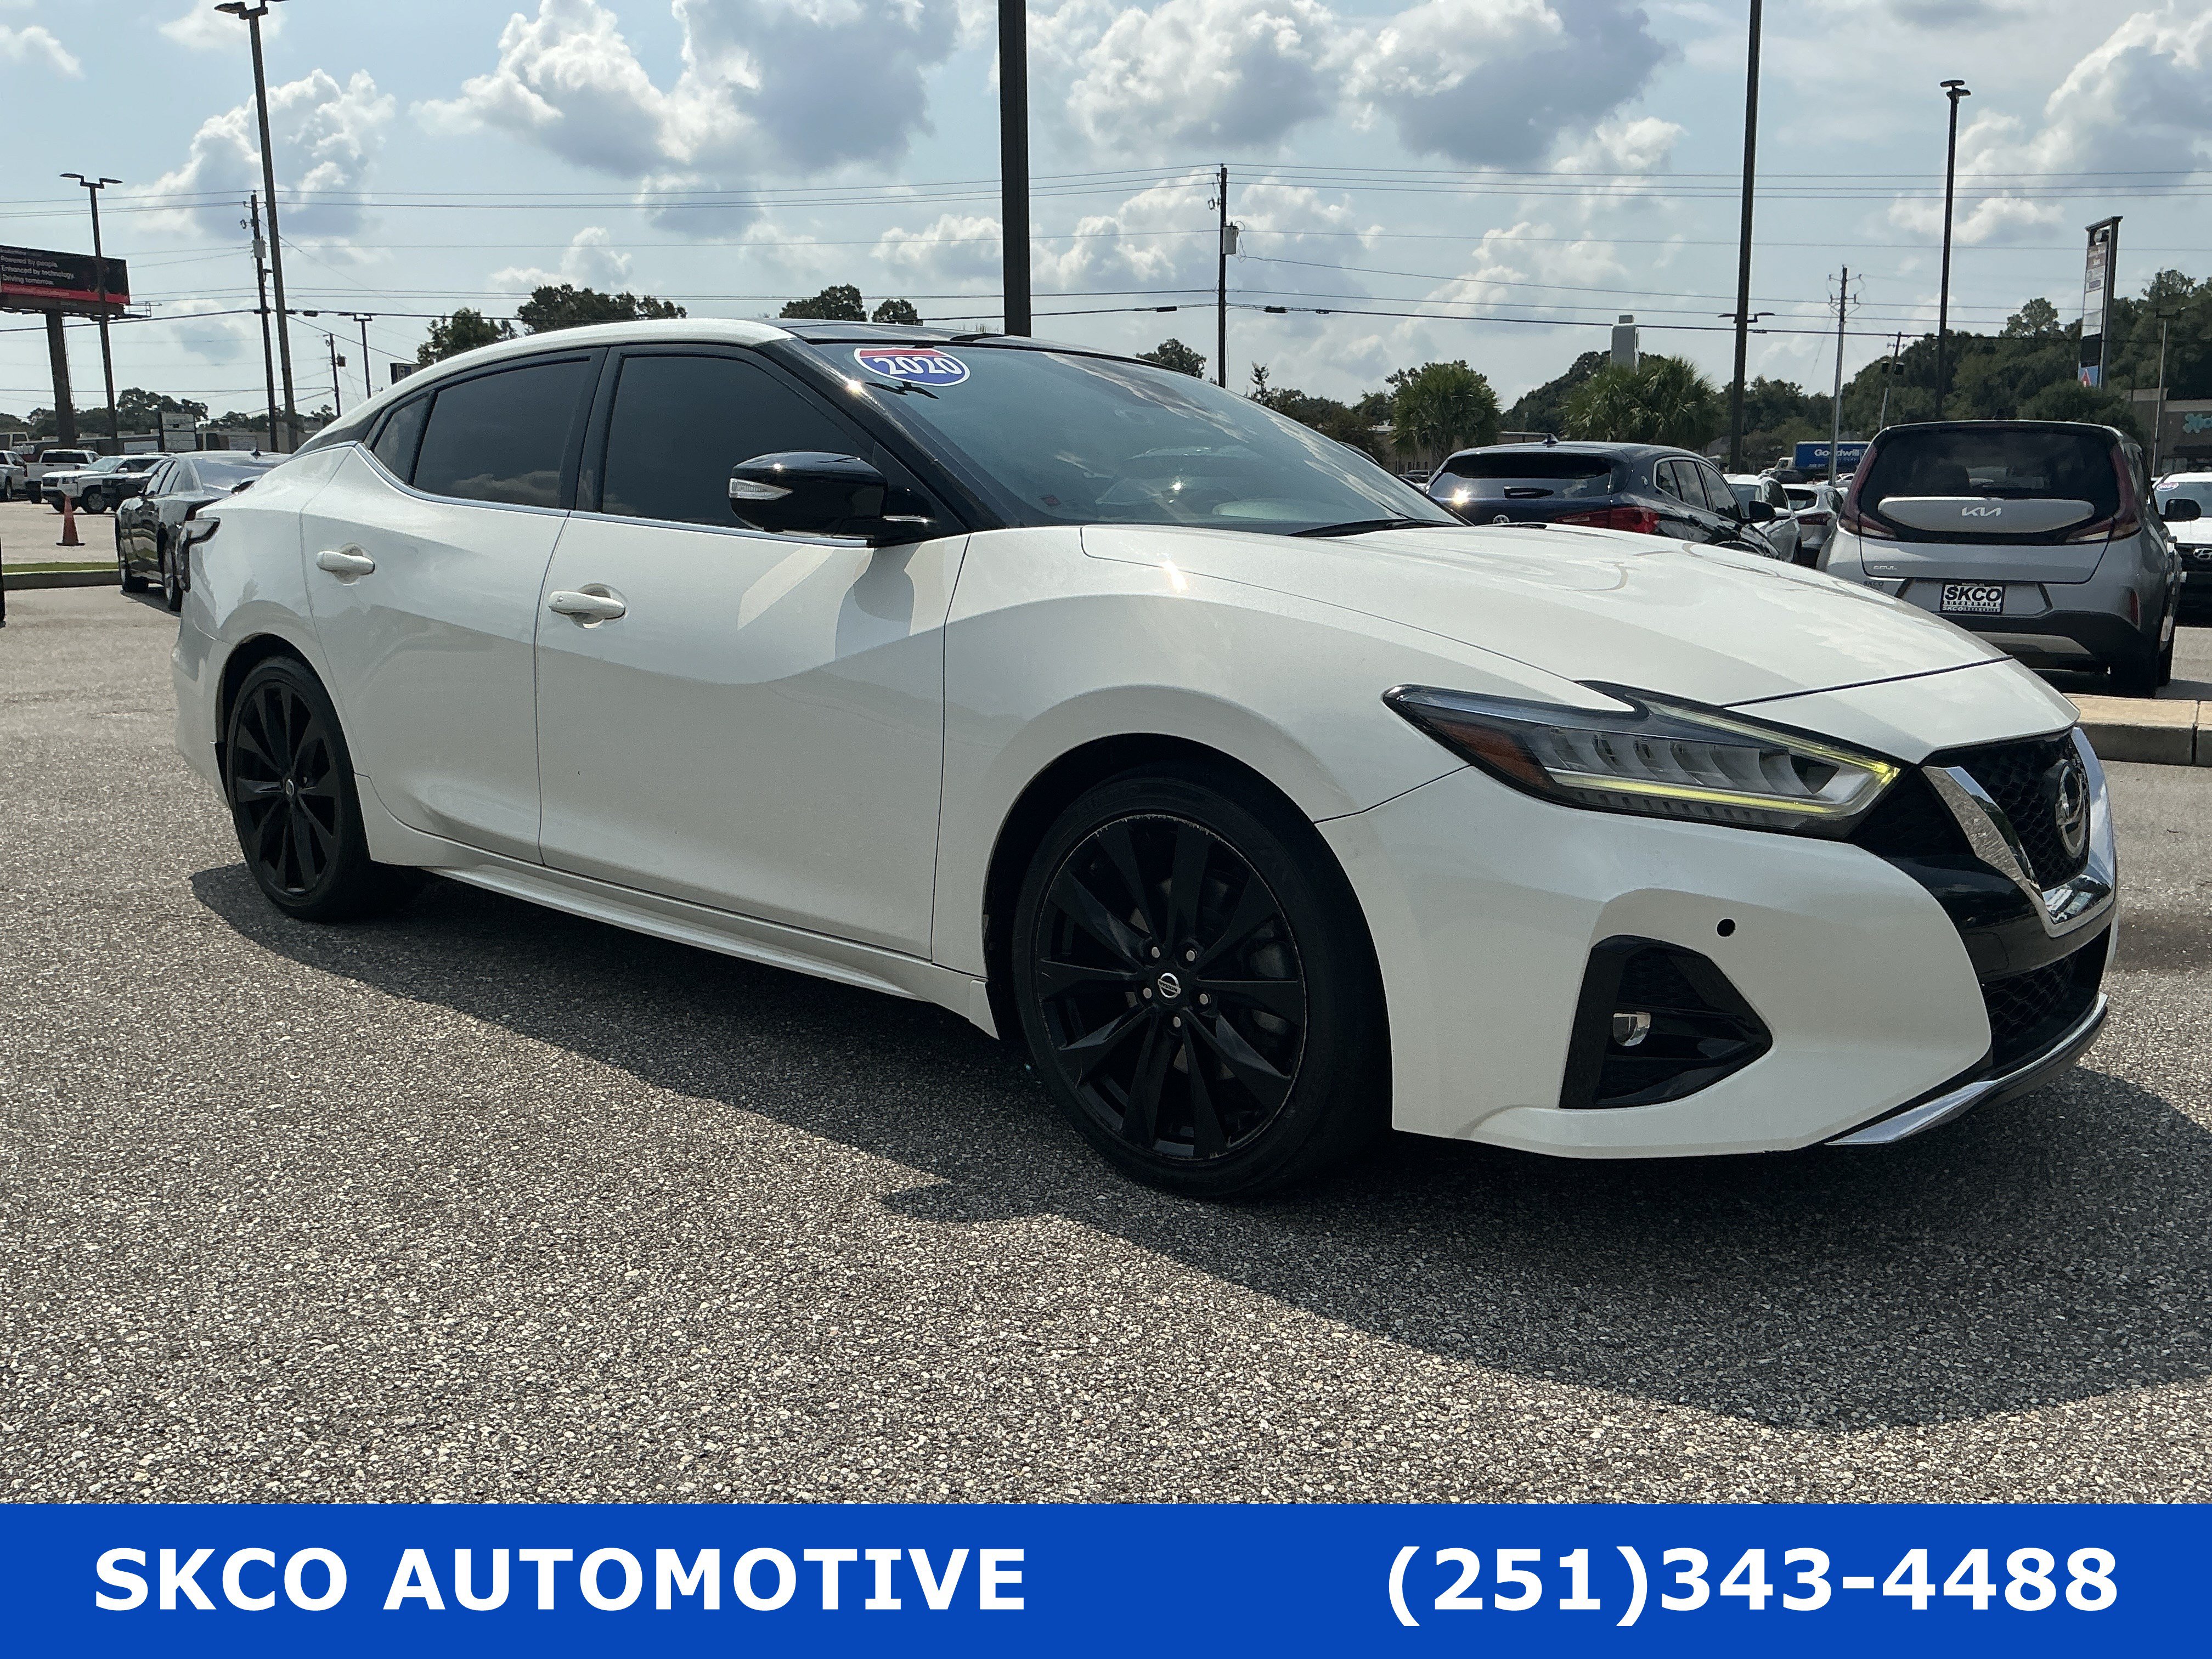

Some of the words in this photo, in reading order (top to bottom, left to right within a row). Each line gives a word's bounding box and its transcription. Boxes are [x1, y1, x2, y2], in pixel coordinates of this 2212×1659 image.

[28, 258, 35, 266] by
[873, 357, 962, 375] 2020
[1945, 586, 2002, 602] SKCO
